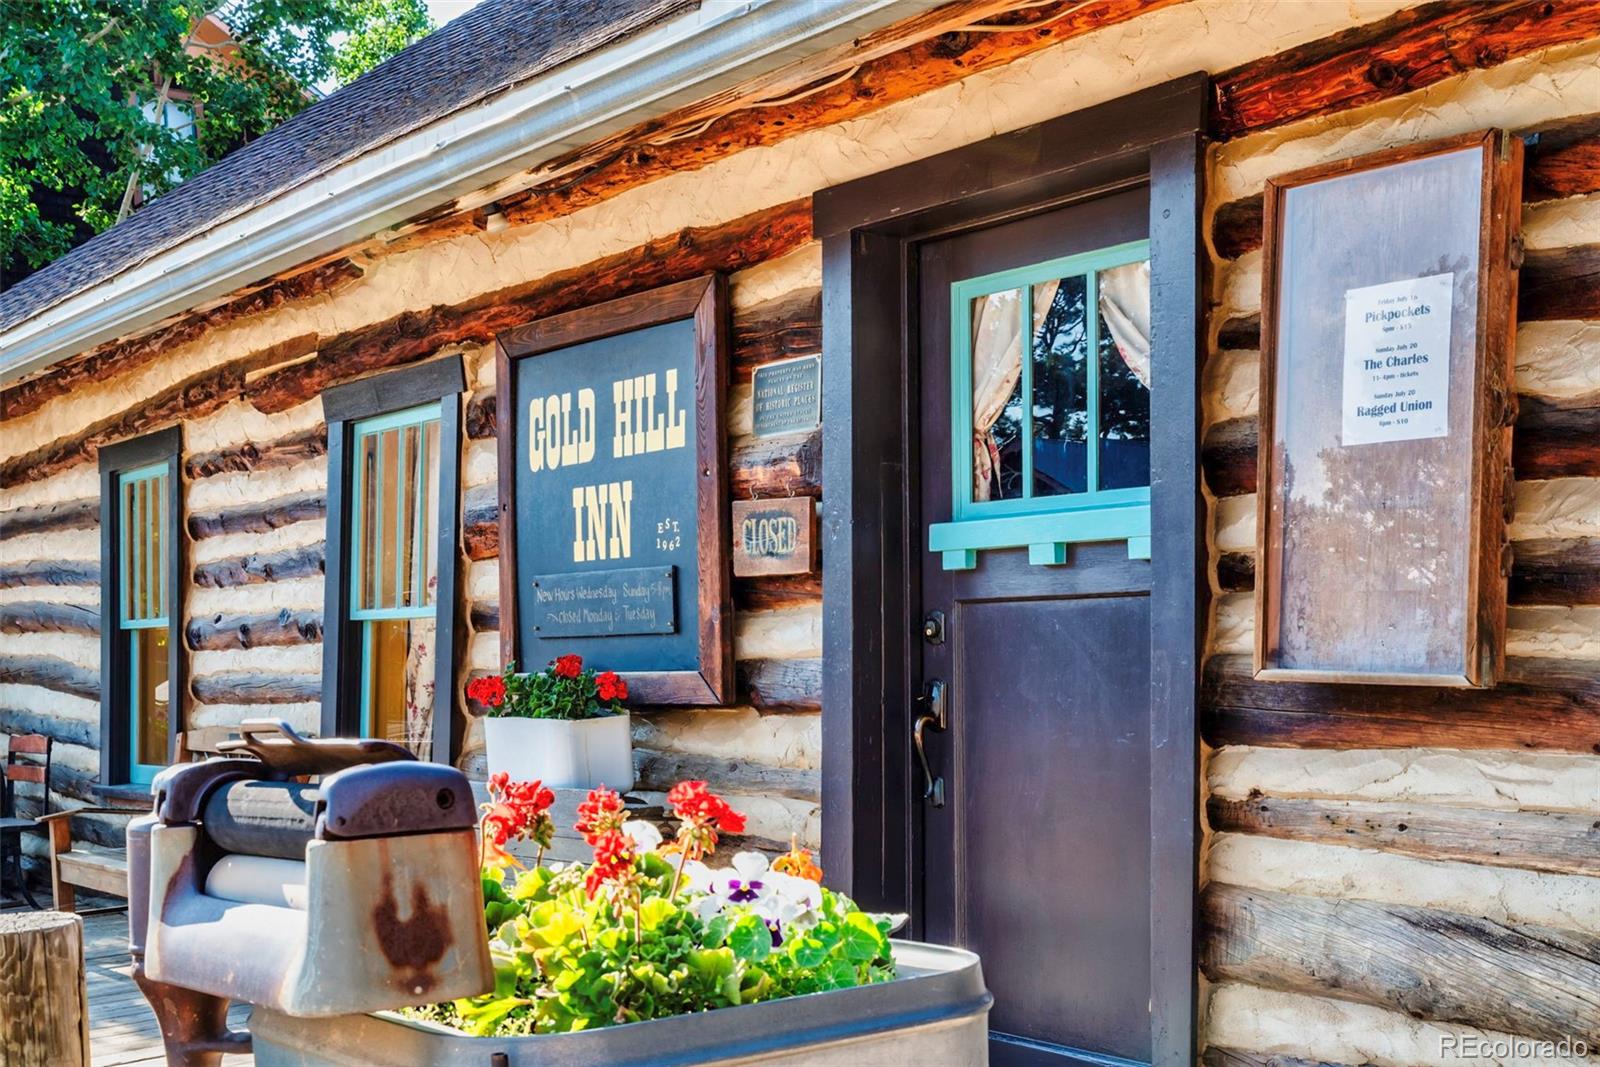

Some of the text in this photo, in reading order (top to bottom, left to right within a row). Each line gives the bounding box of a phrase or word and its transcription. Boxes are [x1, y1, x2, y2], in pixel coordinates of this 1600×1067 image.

[1365, 304, 1431, 322] Pickpockets
[1364, 353, 1429, 370] The Charles
[757, 381, 815, 398] NATIONAL REGISTER
[766, 398, 792, 411] HISTORIC
[794, 395, 816, 406] PLACES
[1357, 400, 1433, 417] Ragged Union
[529, 368, 685, 472] GOLD HILL
[573, 480, 632, 562] INN
[657, 518, 680, 533] EST.
[656, 536, 681, 551] 1962
[743, 517, 797, 554] CLOSED
[536, 588, 553, 603] New
[554, 587, 576, 602] Hours
[576, 584, 617, 605] Wednesday
[623, 582, 650, 604] Sunday
[583, 607, 614, 632] Monday
[622, 605, 656, 629] Tuesday
